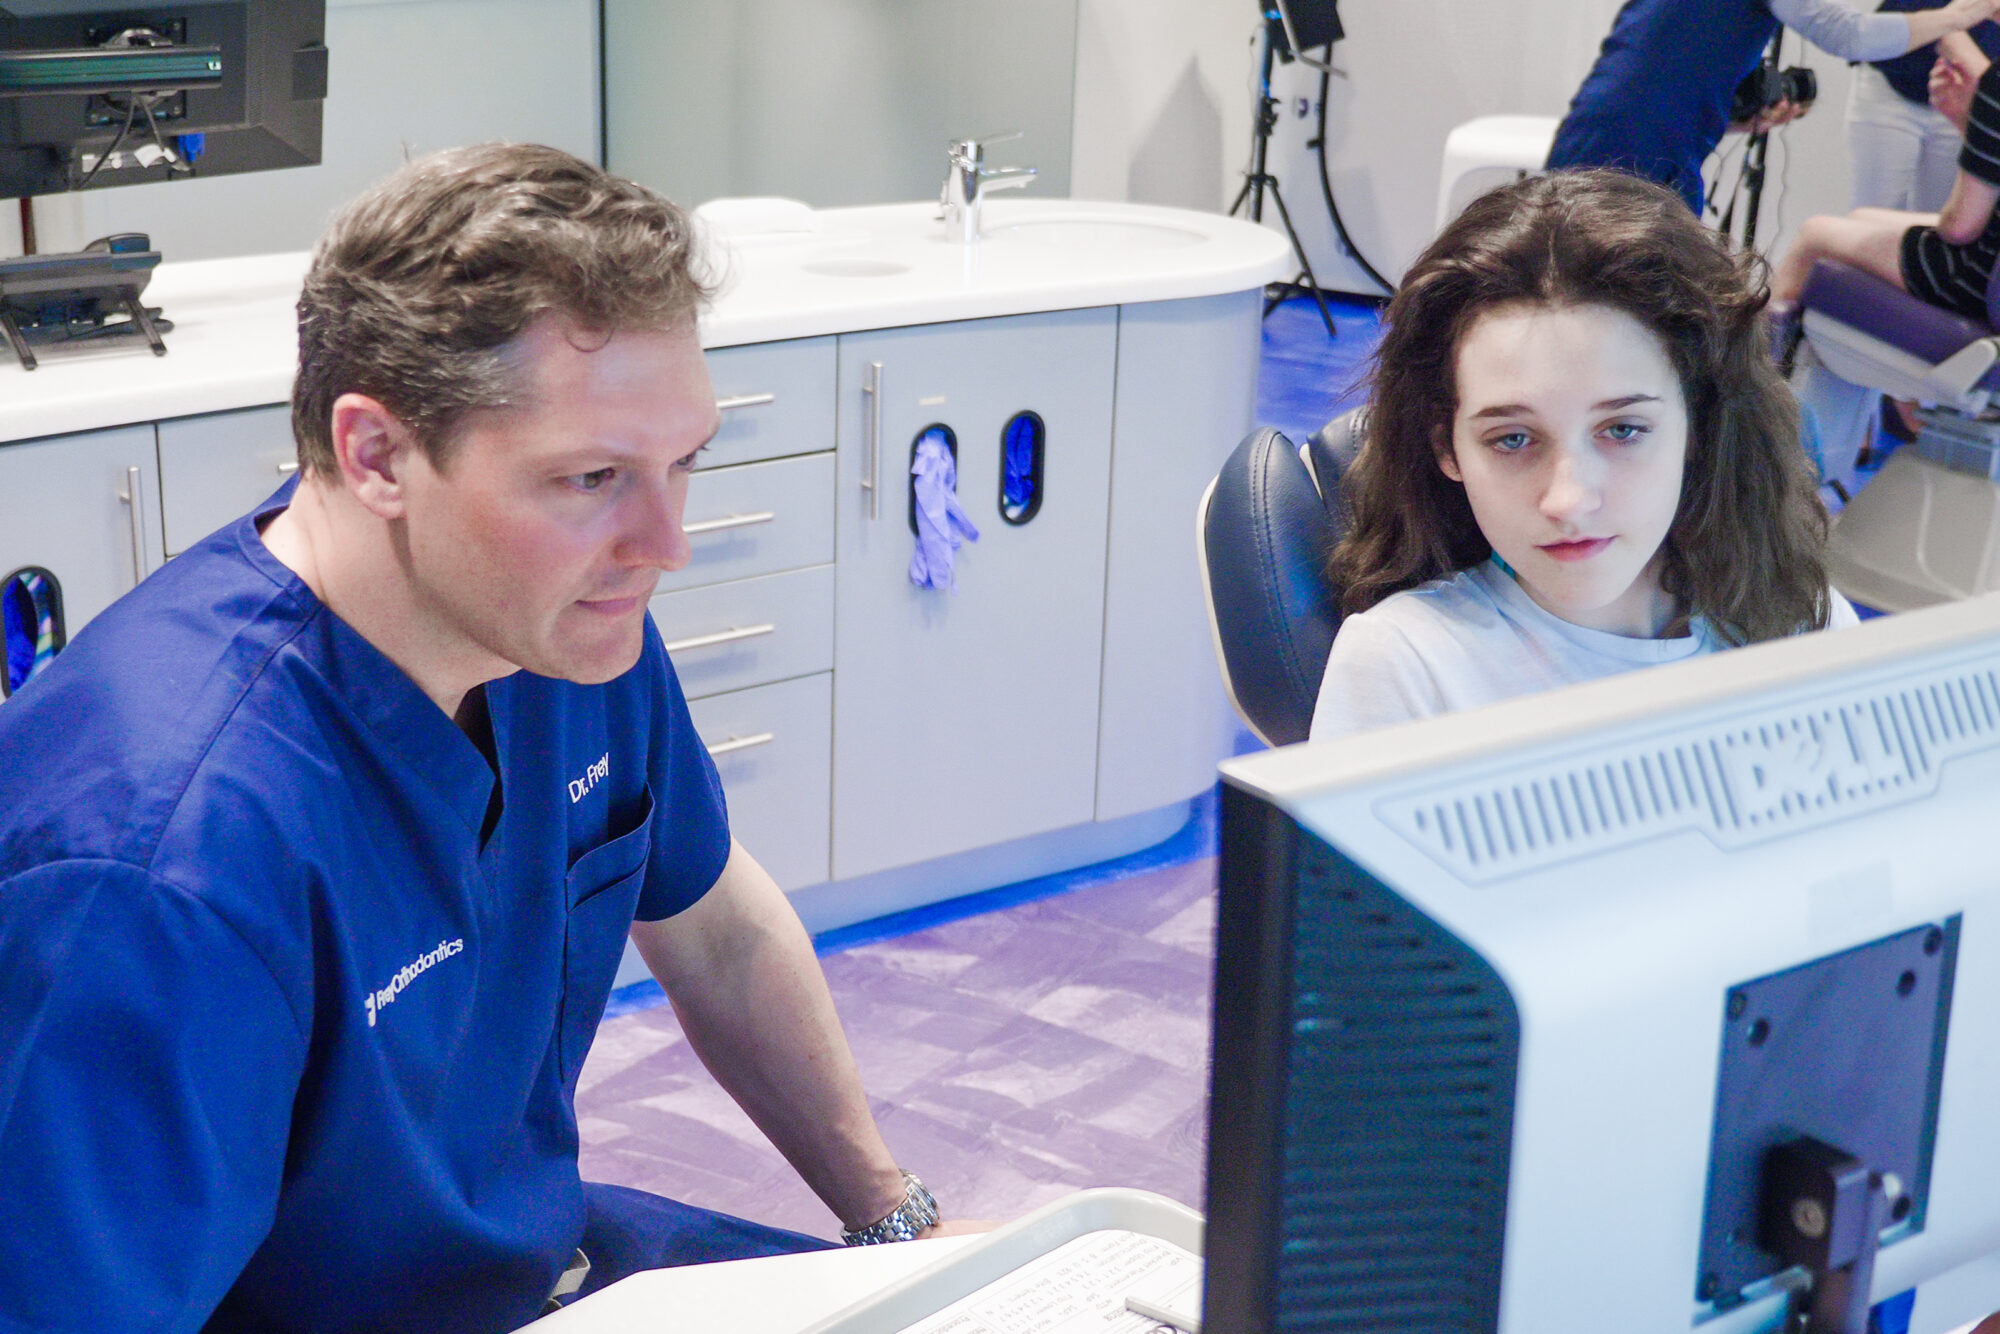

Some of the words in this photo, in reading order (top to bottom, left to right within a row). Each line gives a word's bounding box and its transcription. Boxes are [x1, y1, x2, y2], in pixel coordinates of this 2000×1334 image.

[568, 777, 589, 804] Dr.
[587, 751, 609, 788] Frey
[1727, 713, 1908, 814] DELL
